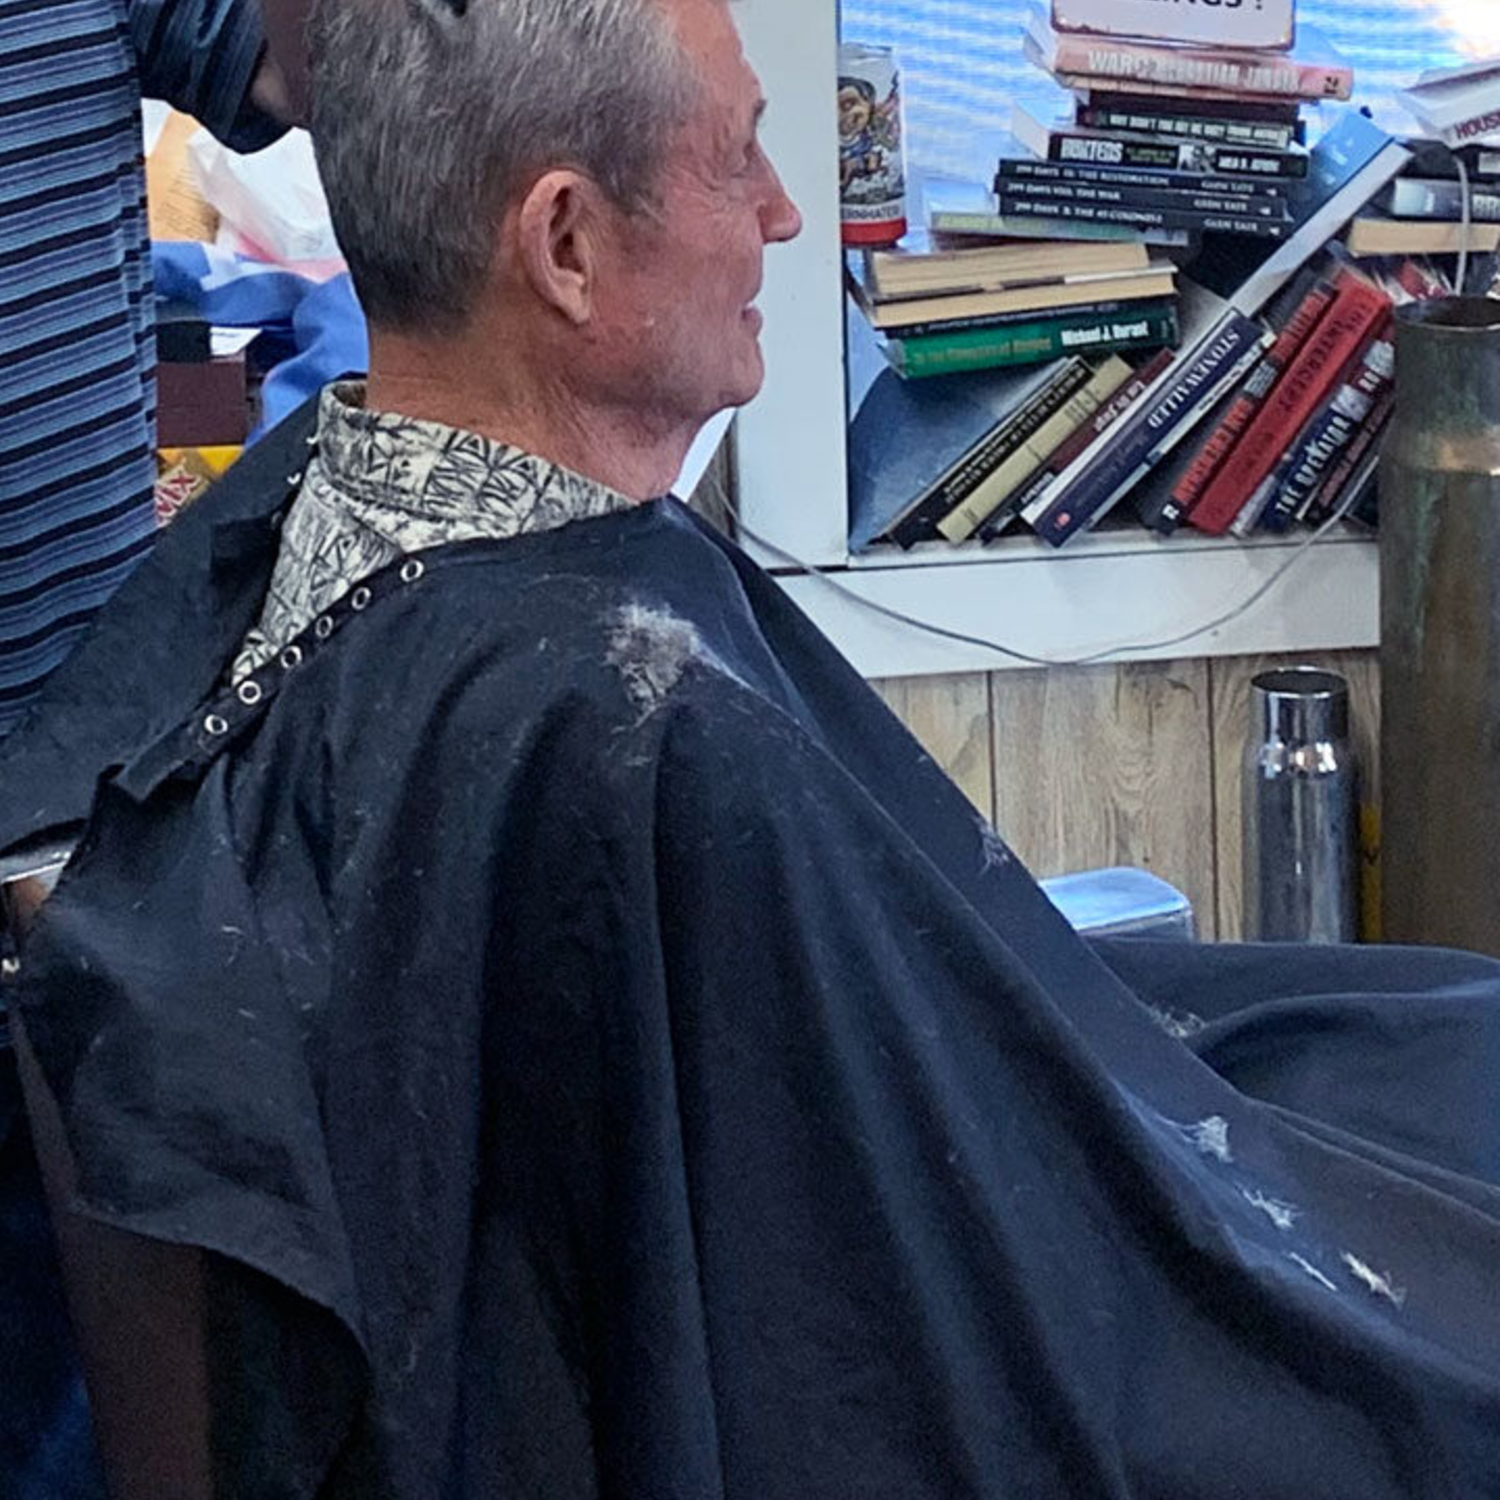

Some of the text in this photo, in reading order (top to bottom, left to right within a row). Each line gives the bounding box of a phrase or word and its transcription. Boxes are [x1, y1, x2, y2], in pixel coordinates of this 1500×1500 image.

[1060, 136, 1125, 164] HUNTERS
[1034, 165, 1060, 178] DAYS
[1097, 188, 1121, 201] WAR
[1032, 202, 1060, 215] DAYS
[1074, 205, 1095, 218] THE
[1061, 328, 1102, 347] Michael
[1147, 323, 1239, 434] STONEWALLED
[1272, 411, 1357, 518] THE OPERATOR
